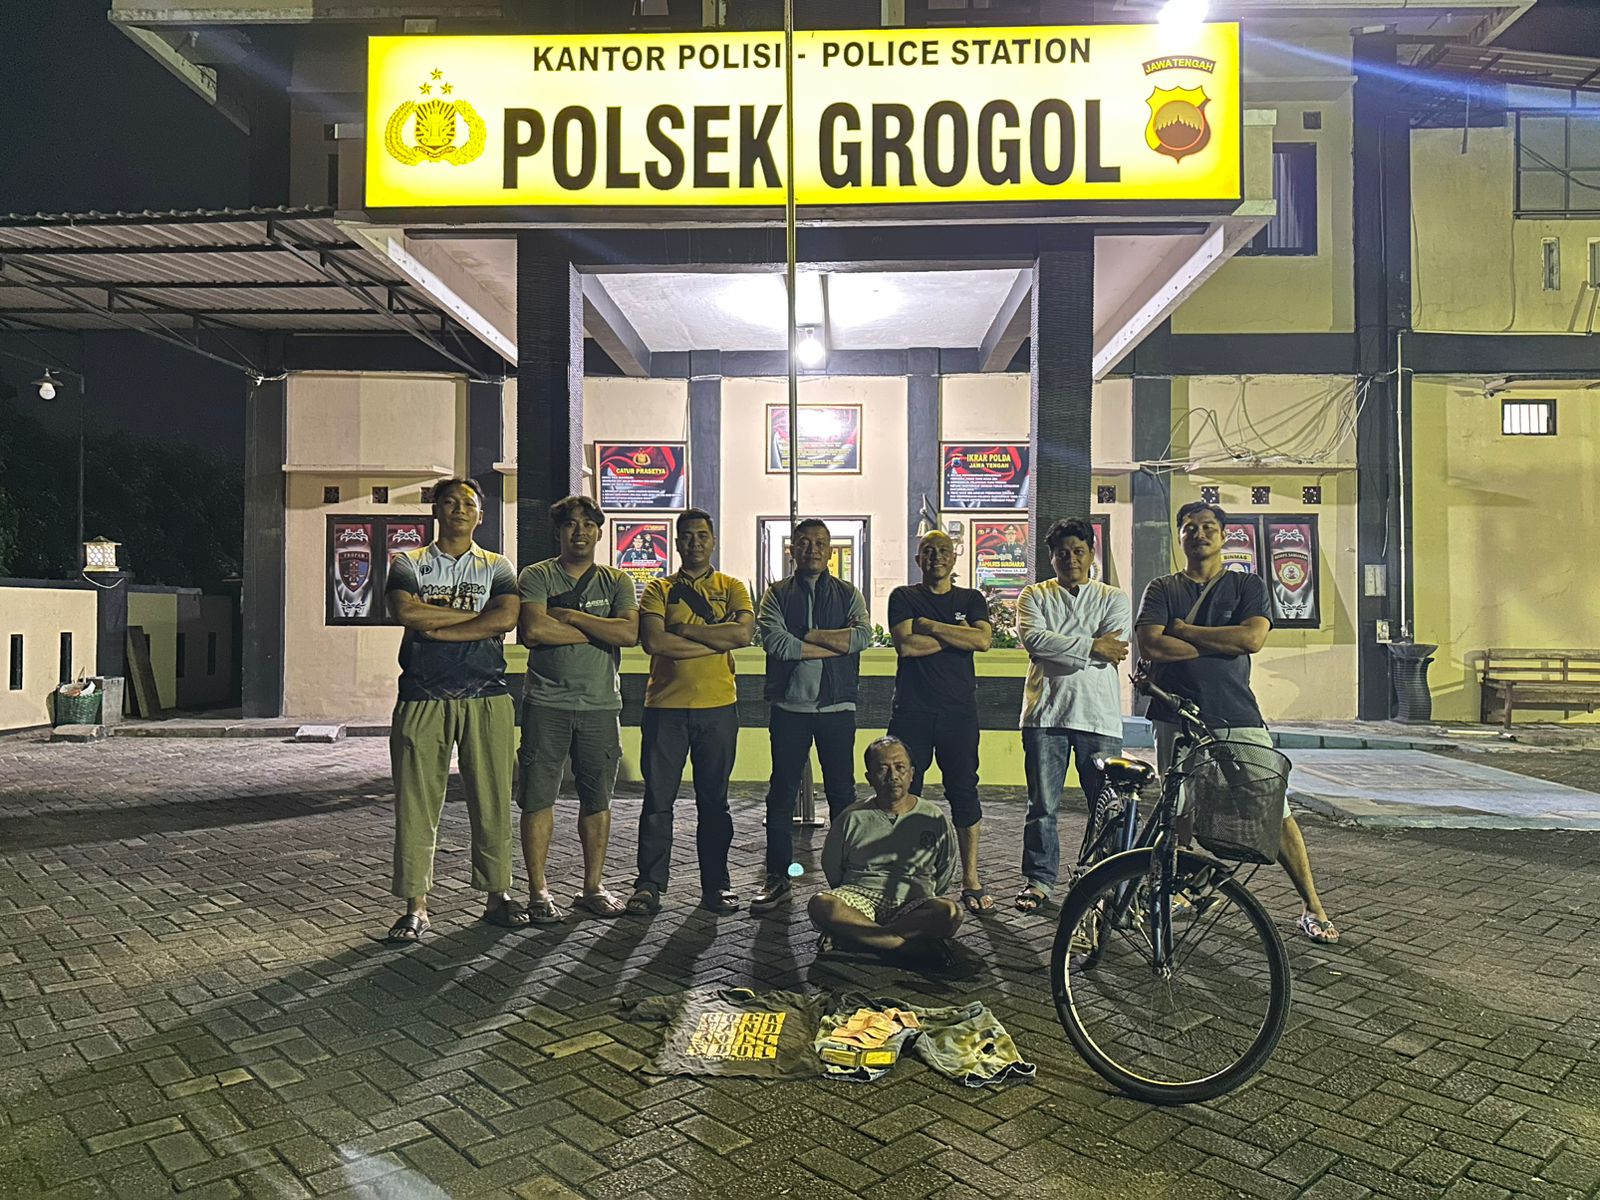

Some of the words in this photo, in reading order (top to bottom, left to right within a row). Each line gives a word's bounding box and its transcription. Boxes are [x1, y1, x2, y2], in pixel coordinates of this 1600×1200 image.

[534, 46, 666, 71] KANTOR
[679, 43, 782, 70] POLISI
[823, 40, 939, 67] POLICE
[951, 37, 1091, 65] STATION
[1145, 60, 1173, 73] JAWA
[1173, 58, 1213, 72] TENGAH
[502, 104, 784, 191] POLSEK
[819, 98, 1122, 189] GROGOL
[966, 453, 988, 462] IKRAR
[988, 453, 1011, 462] POLDA
[459, 581, 487, 596] SOBA
